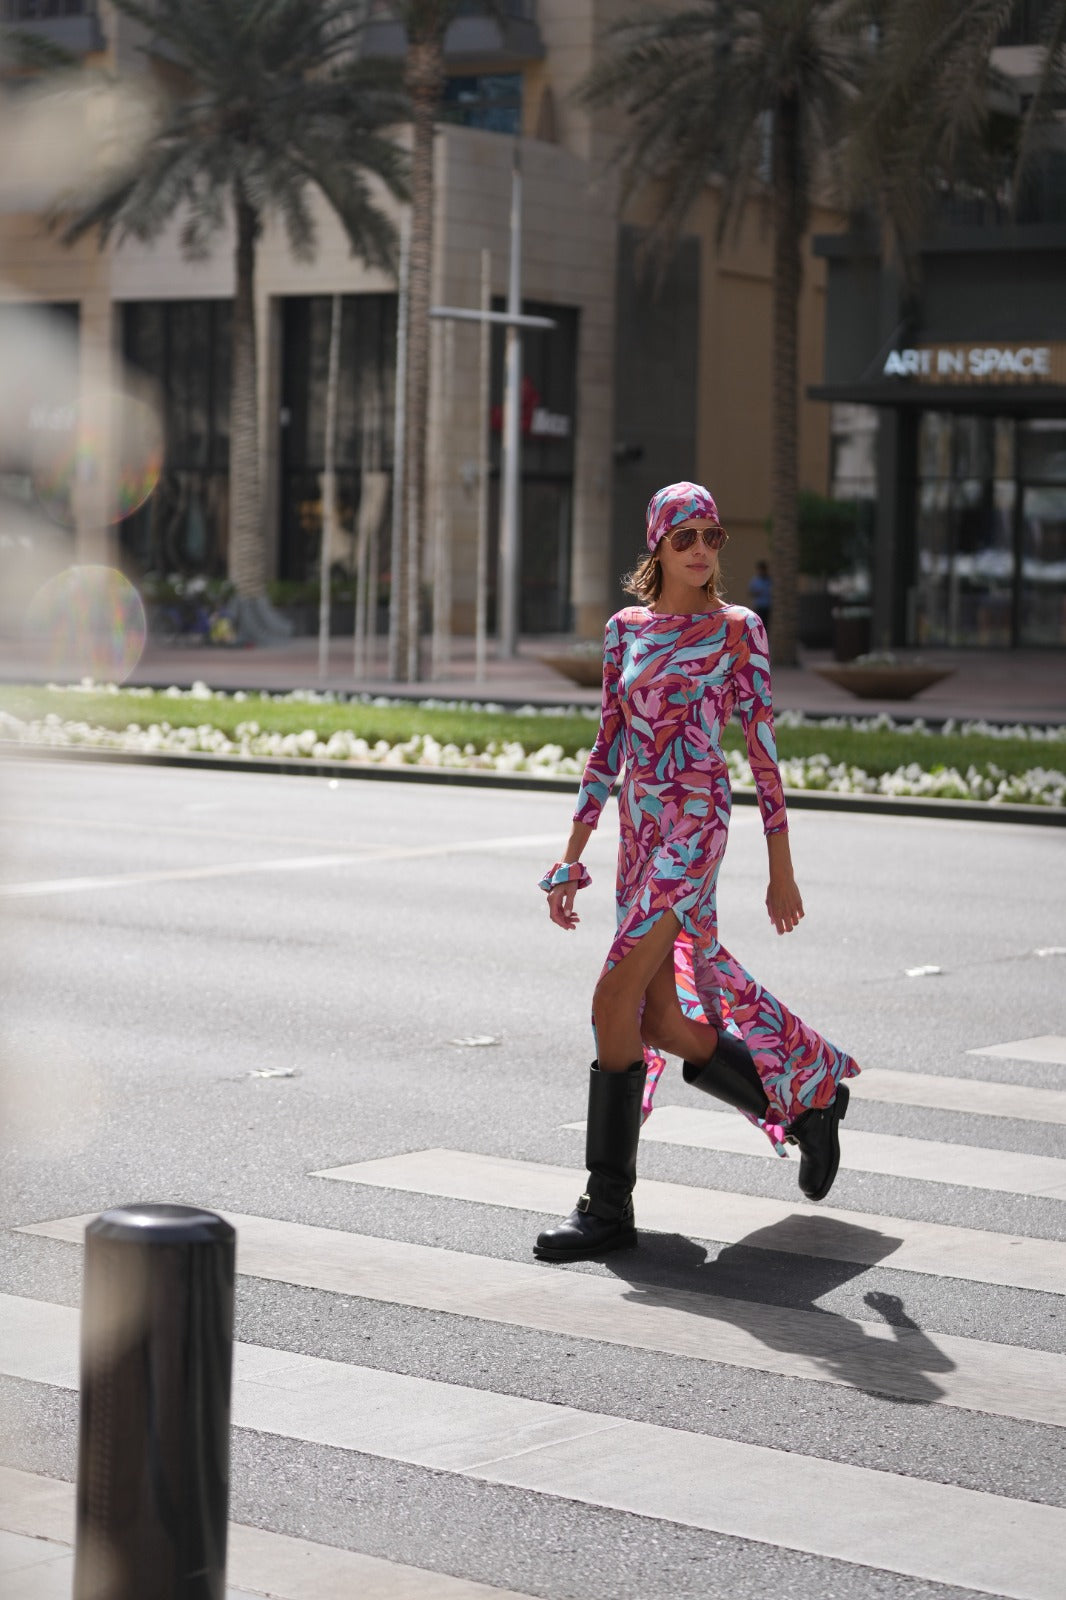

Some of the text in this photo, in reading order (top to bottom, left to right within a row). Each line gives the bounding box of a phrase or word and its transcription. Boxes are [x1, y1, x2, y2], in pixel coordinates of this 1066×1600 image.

[884, 348, 1049, 375] ART IN SPACE
